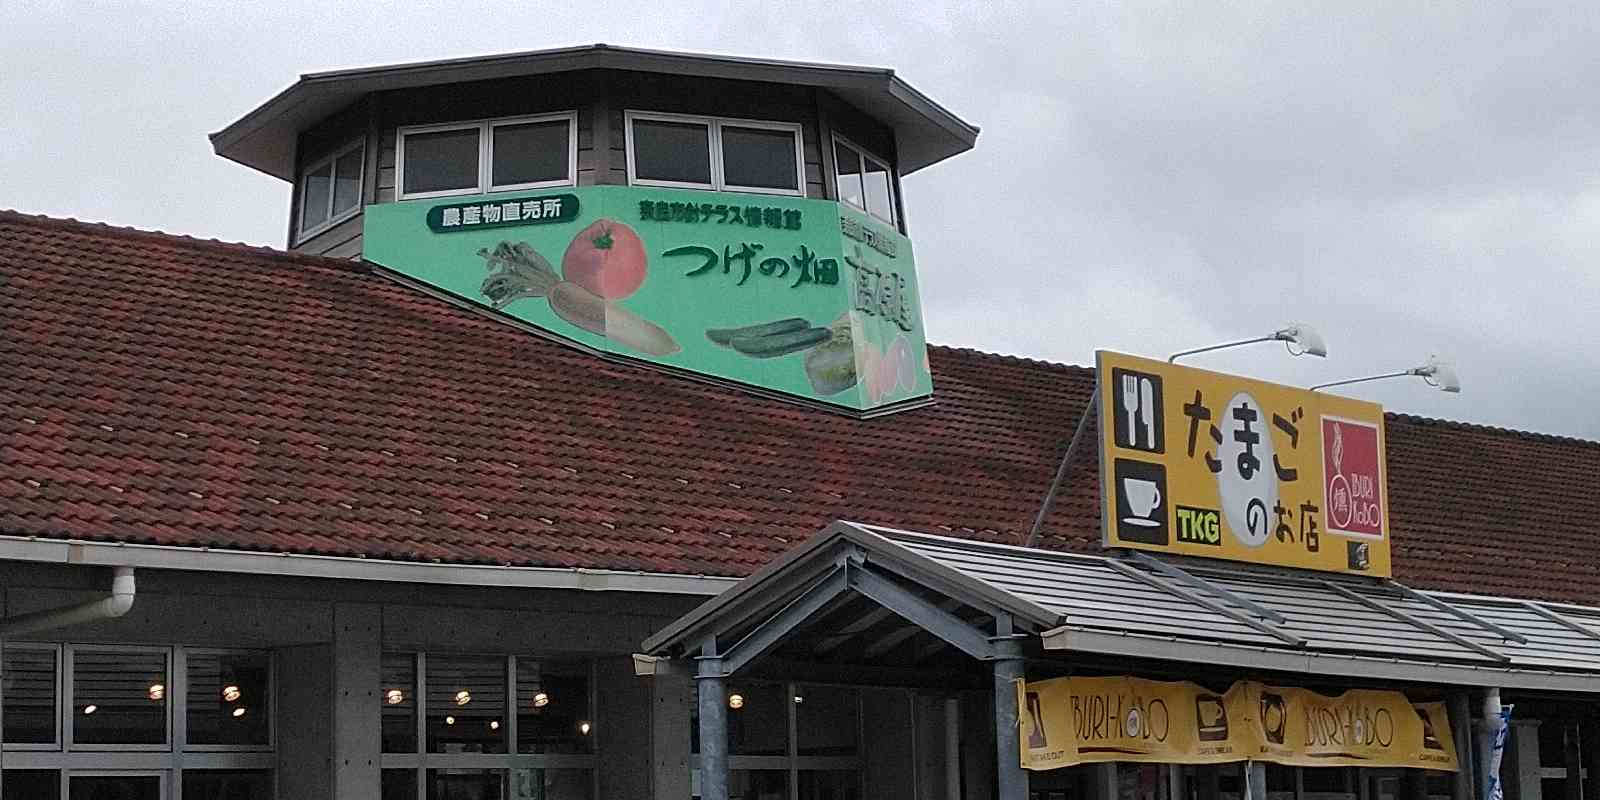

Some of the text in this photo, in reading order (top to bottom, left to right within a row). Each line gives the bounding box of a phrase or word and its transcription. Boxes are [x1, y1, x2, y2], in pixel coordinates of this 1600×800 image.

[442, 198, 562, 227] 農産物直売所
[662, 242, 840, 289] つげの畑
[1183, 389, 1304, 481] たまご
[1176, 509, 1219, 544] TKG
[1246, 497, 1320, 553] のお店
